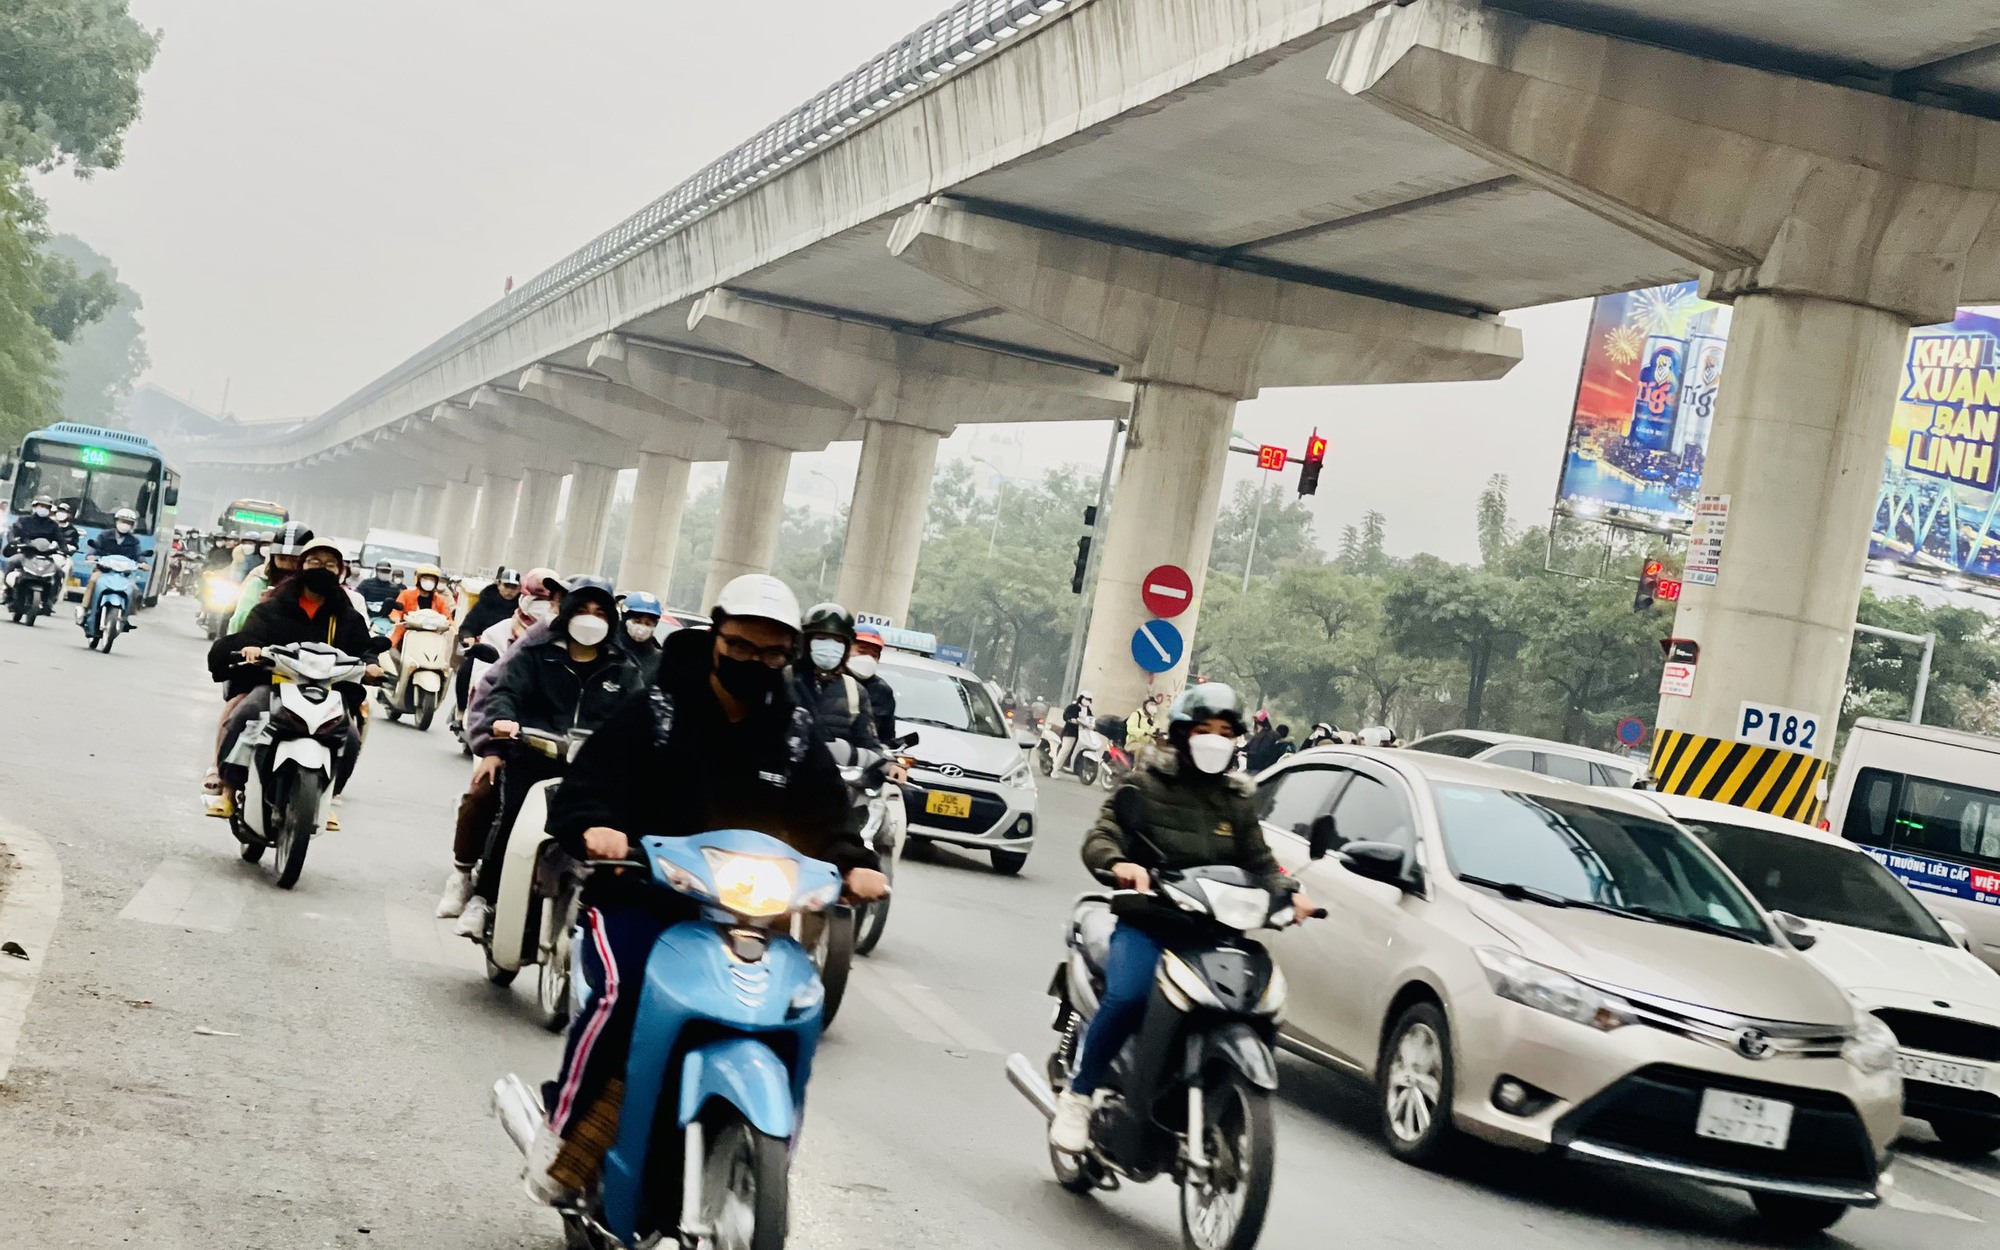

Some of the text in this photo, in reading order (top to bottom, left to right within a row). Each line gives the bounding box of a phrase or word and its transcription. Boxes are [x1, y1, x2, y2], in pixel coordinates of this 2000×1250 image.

[1912, 338, 1981, 367] KHAI
[1907, 358, 2000, 407] XUÂN
[1742, 708, 1816, 750] P182
